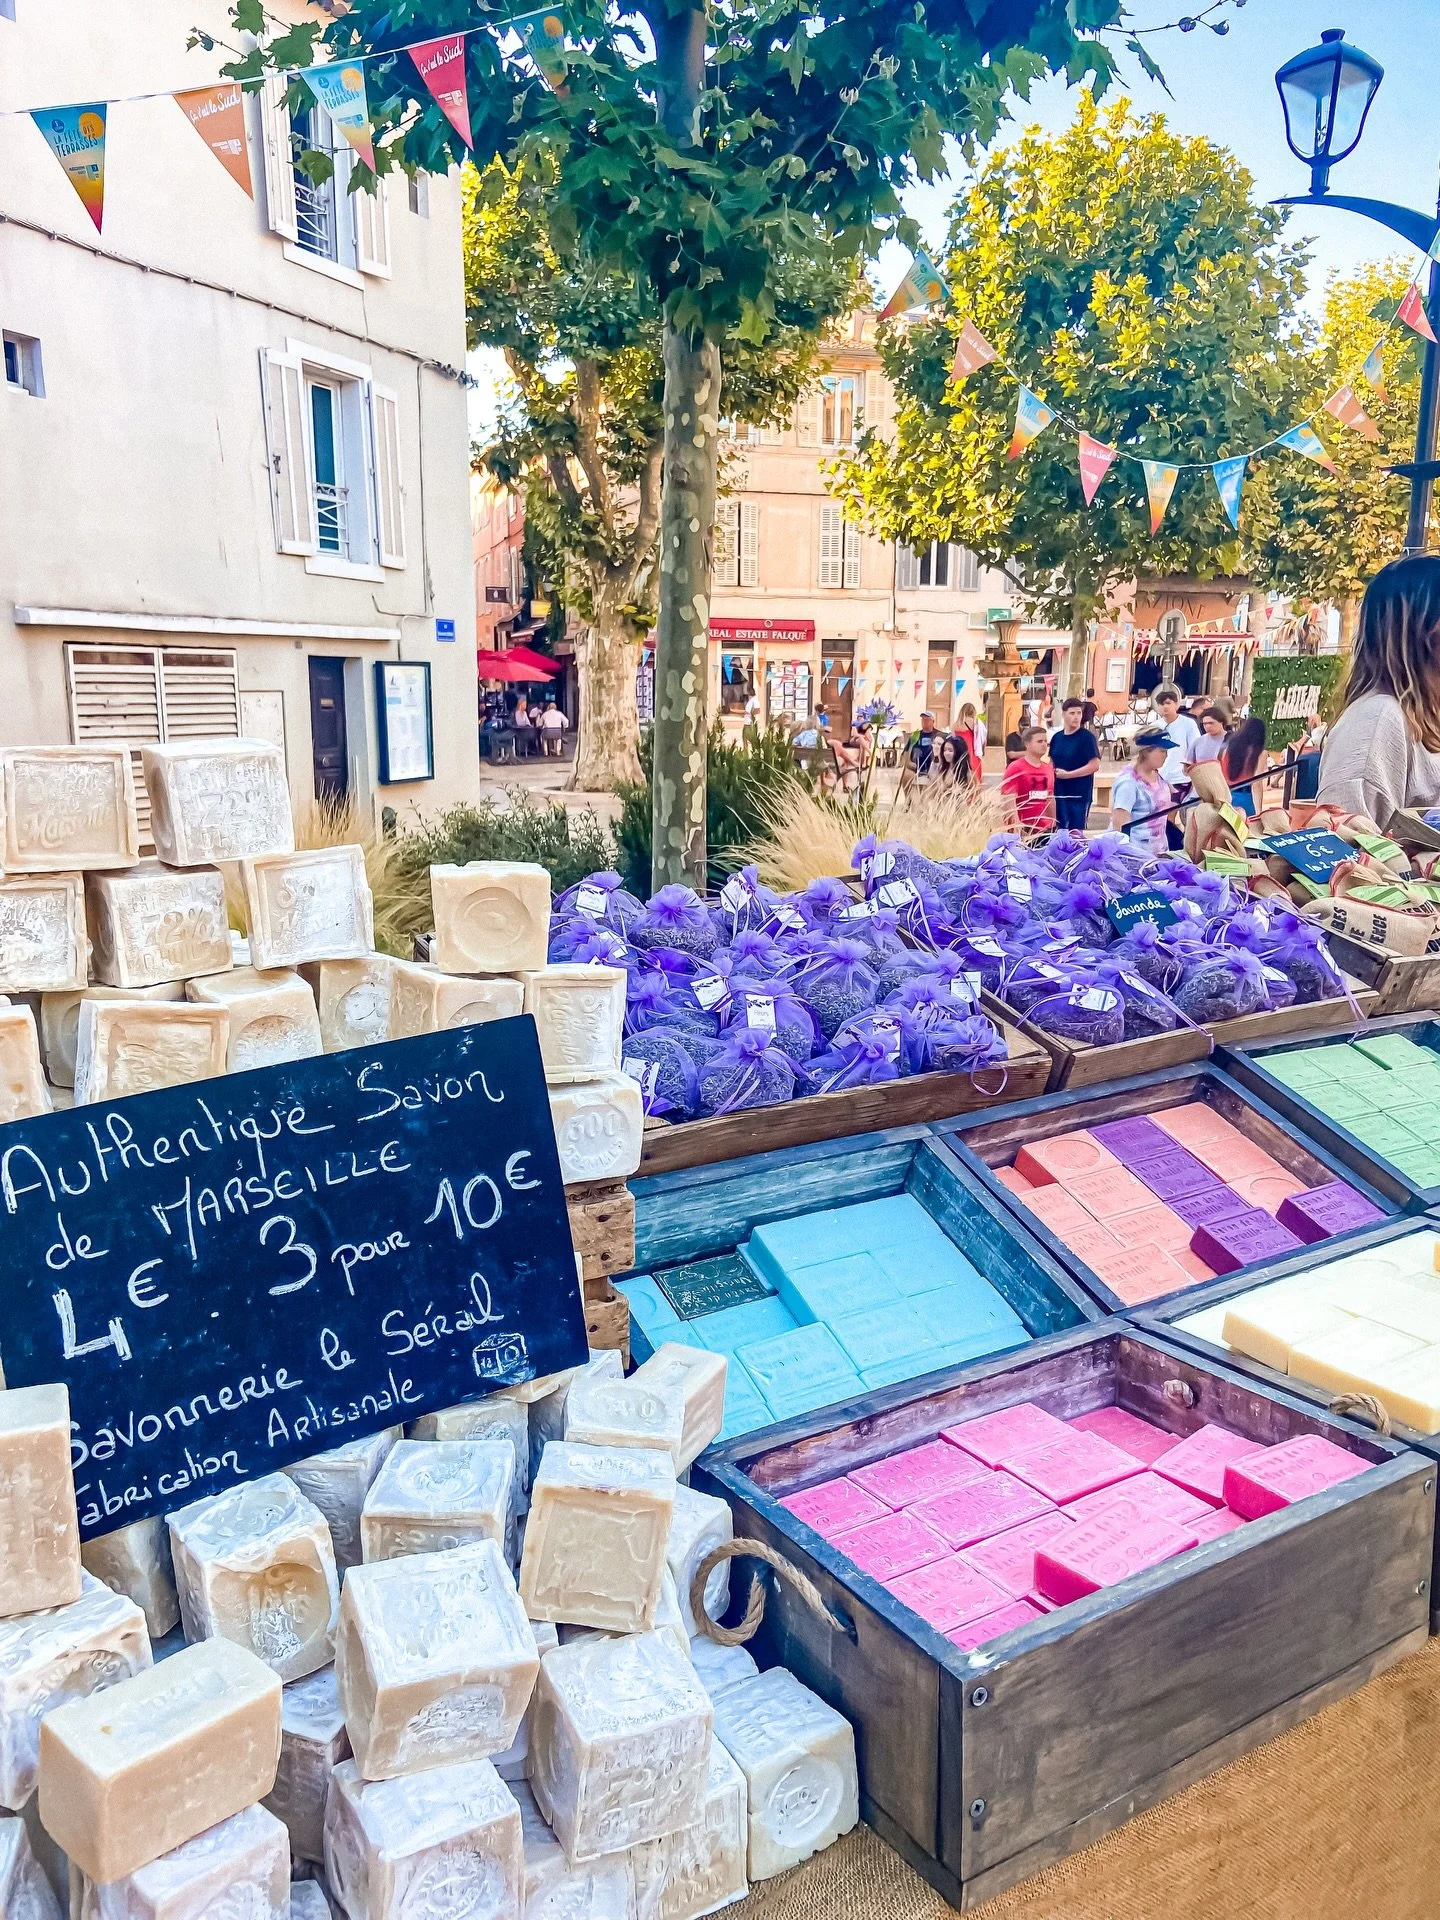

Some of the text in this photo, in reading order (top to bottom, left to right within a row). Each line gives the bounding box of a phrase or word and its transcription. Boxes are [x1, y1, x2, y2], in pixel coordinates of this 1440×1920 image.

[443, 37, 464, 63] Sud
[217, 85, 241, 111] Sud
[56, 134, 98, 157] TERRASSES
[709, 629, 731, 638] REAL
[735, 630, 768, 640] ESTATE
[1305, 843, 1335, 858] 6€
[1111, 897, 1167, 919] Lavande
[2, 1062, 505, 1213] Authentique Savon
[45, 1140, 412, 1270] de MARSEILLE
[259, 1215, 317, 1296] 3
[424, 1150, 543, 1239] 10€
[68, 1272, 505, 1471] Savonnerie le Sérail
[266, 1375, 424, 1447] Artisanale
